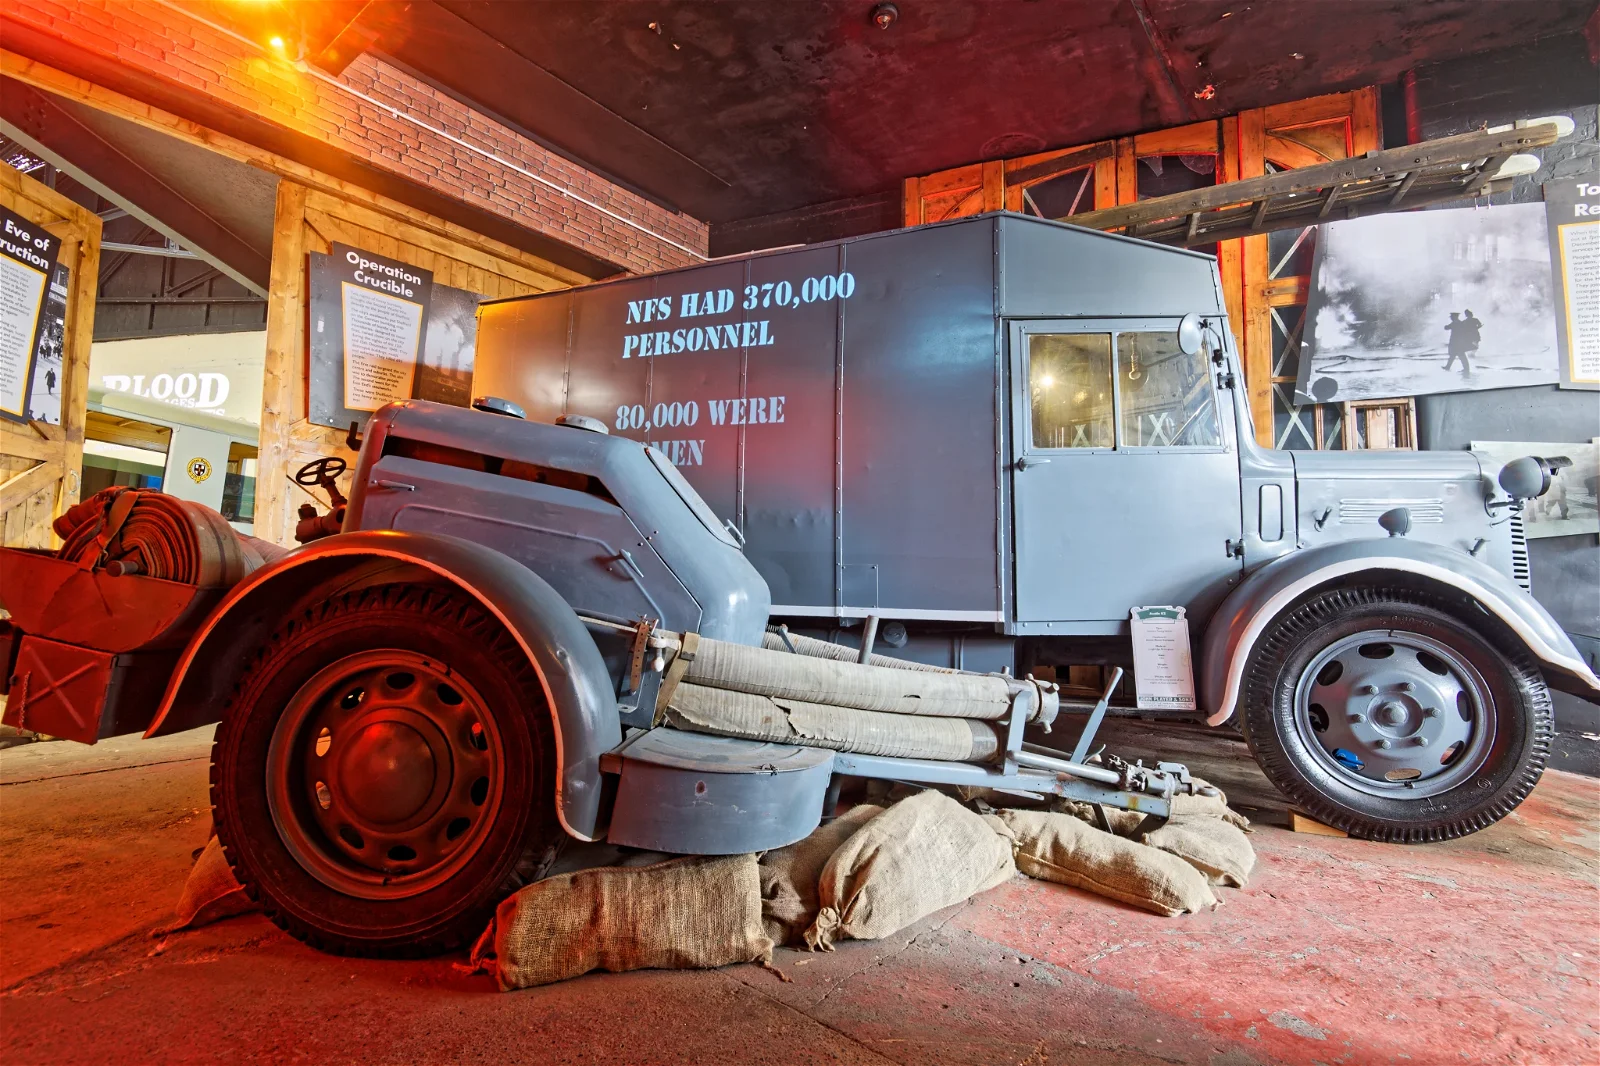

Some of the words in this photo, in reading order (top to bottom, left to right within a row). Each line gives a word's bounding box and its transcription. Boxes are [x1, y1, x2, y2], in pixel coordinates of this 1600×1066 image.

[5, 219, 31, 242] Eve
[34, 239, 50, 251] of
[0, 238, 49, 270] ruction
[346, 252, 421, 285] Operation
[354, 270, 413, 298] Crucible
[626, 295, 672, 324] NFS
[680, 288, 734, 318] HAD
[742, 272, 856, 310] 370,000
[622, 320, 774, 359] PERSONNEL
[615, 400, 699, 433] 80,000
[708, 396, 786, 426] WERE
[641, 439, 706, 466] MEN
